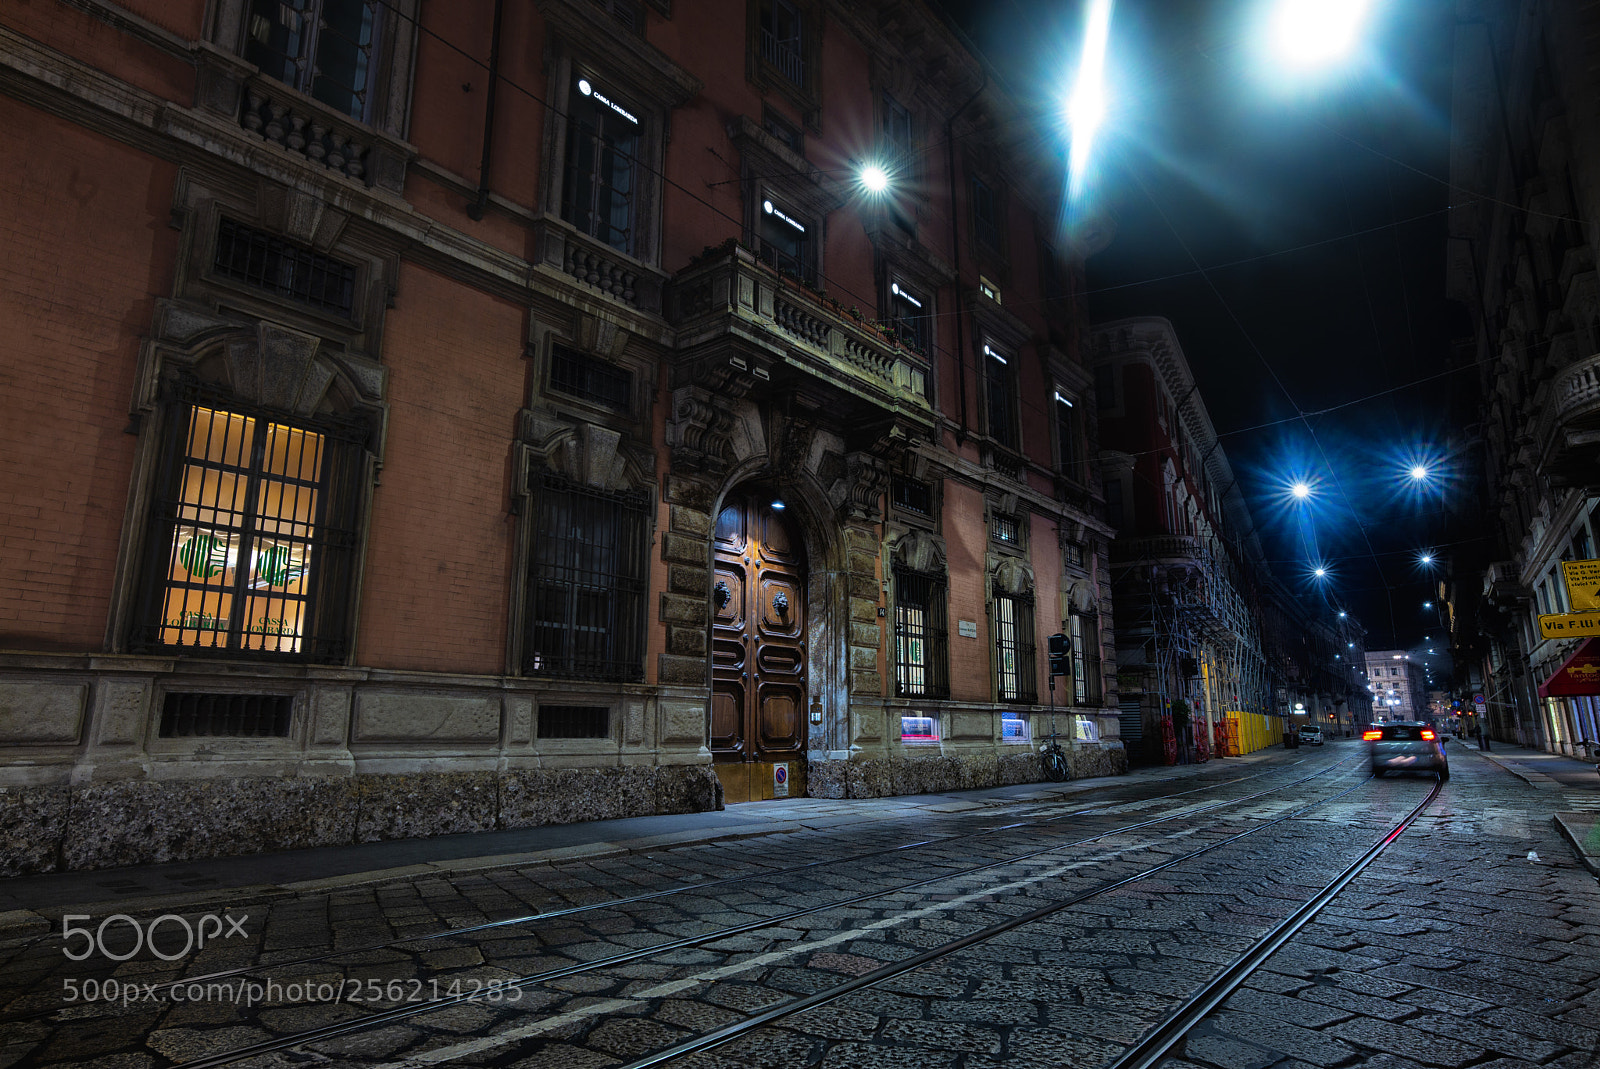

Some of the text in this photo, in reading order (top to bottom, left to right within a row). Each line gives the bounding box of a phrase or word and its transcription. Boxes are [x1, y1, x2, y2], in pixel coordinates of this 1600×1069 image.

[246, 624, 299, 637] LOMBARD
[1544, 622, 1564, 630] Via
[1569, 619, 1594, 629] F.lli
